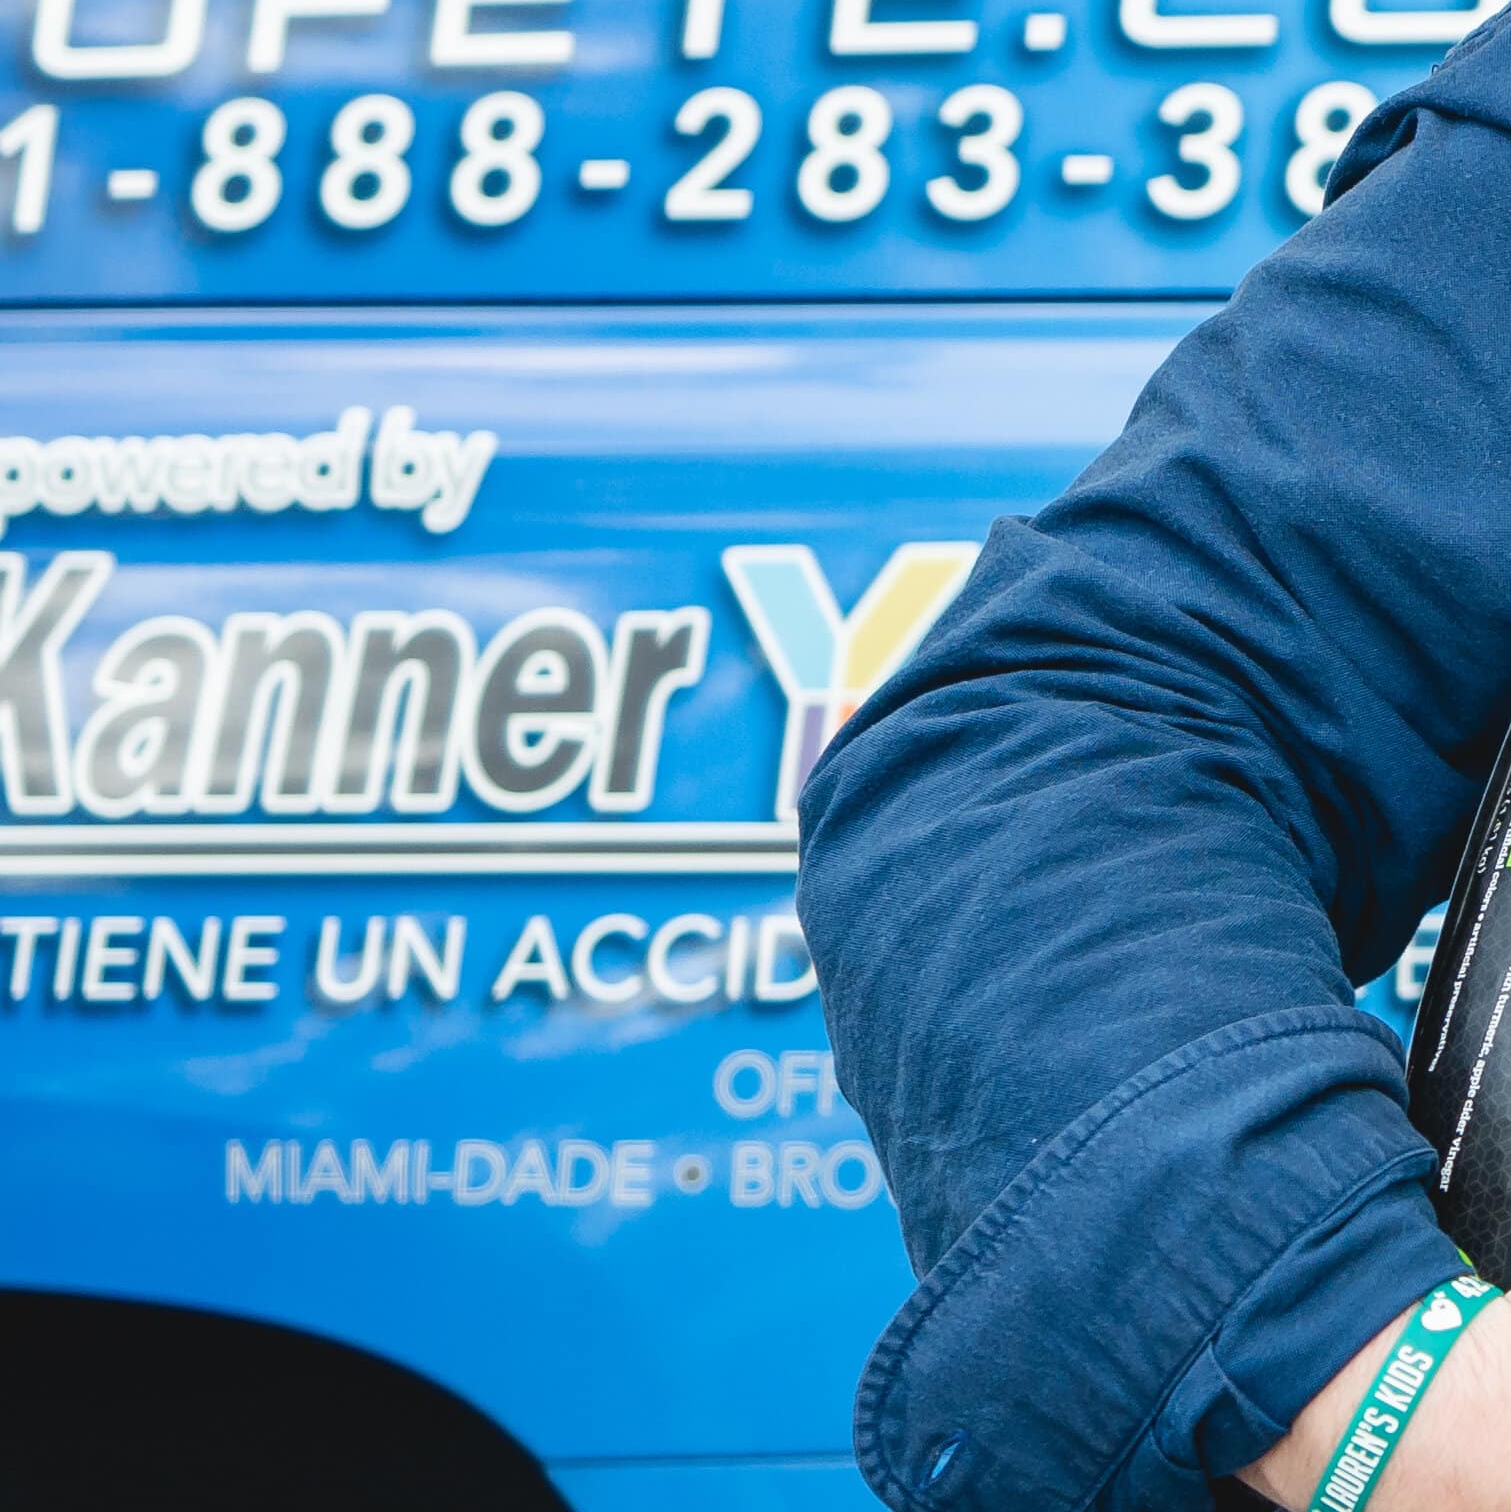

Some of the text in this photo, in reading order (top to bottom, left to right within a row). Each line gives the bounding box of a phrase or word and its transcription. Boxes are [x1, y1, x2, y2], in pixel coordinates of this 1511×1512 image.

[0, 404, 498, 542] powered by
[0, 550, 710, 818] Kanner
[0, 915, 287, 1003] TIENE
[315, 915, 468, 1003] UN
[1466, 1059, 1486, 1098] apple
[1455, 1099, 1474, 1136] cider
[225, 1139, 898, 1211] MIAMI-DADE BRO
[1439, 1136, 1462, 1193] vinegar
[1374, 1345, 1434, 1413] KIDS
